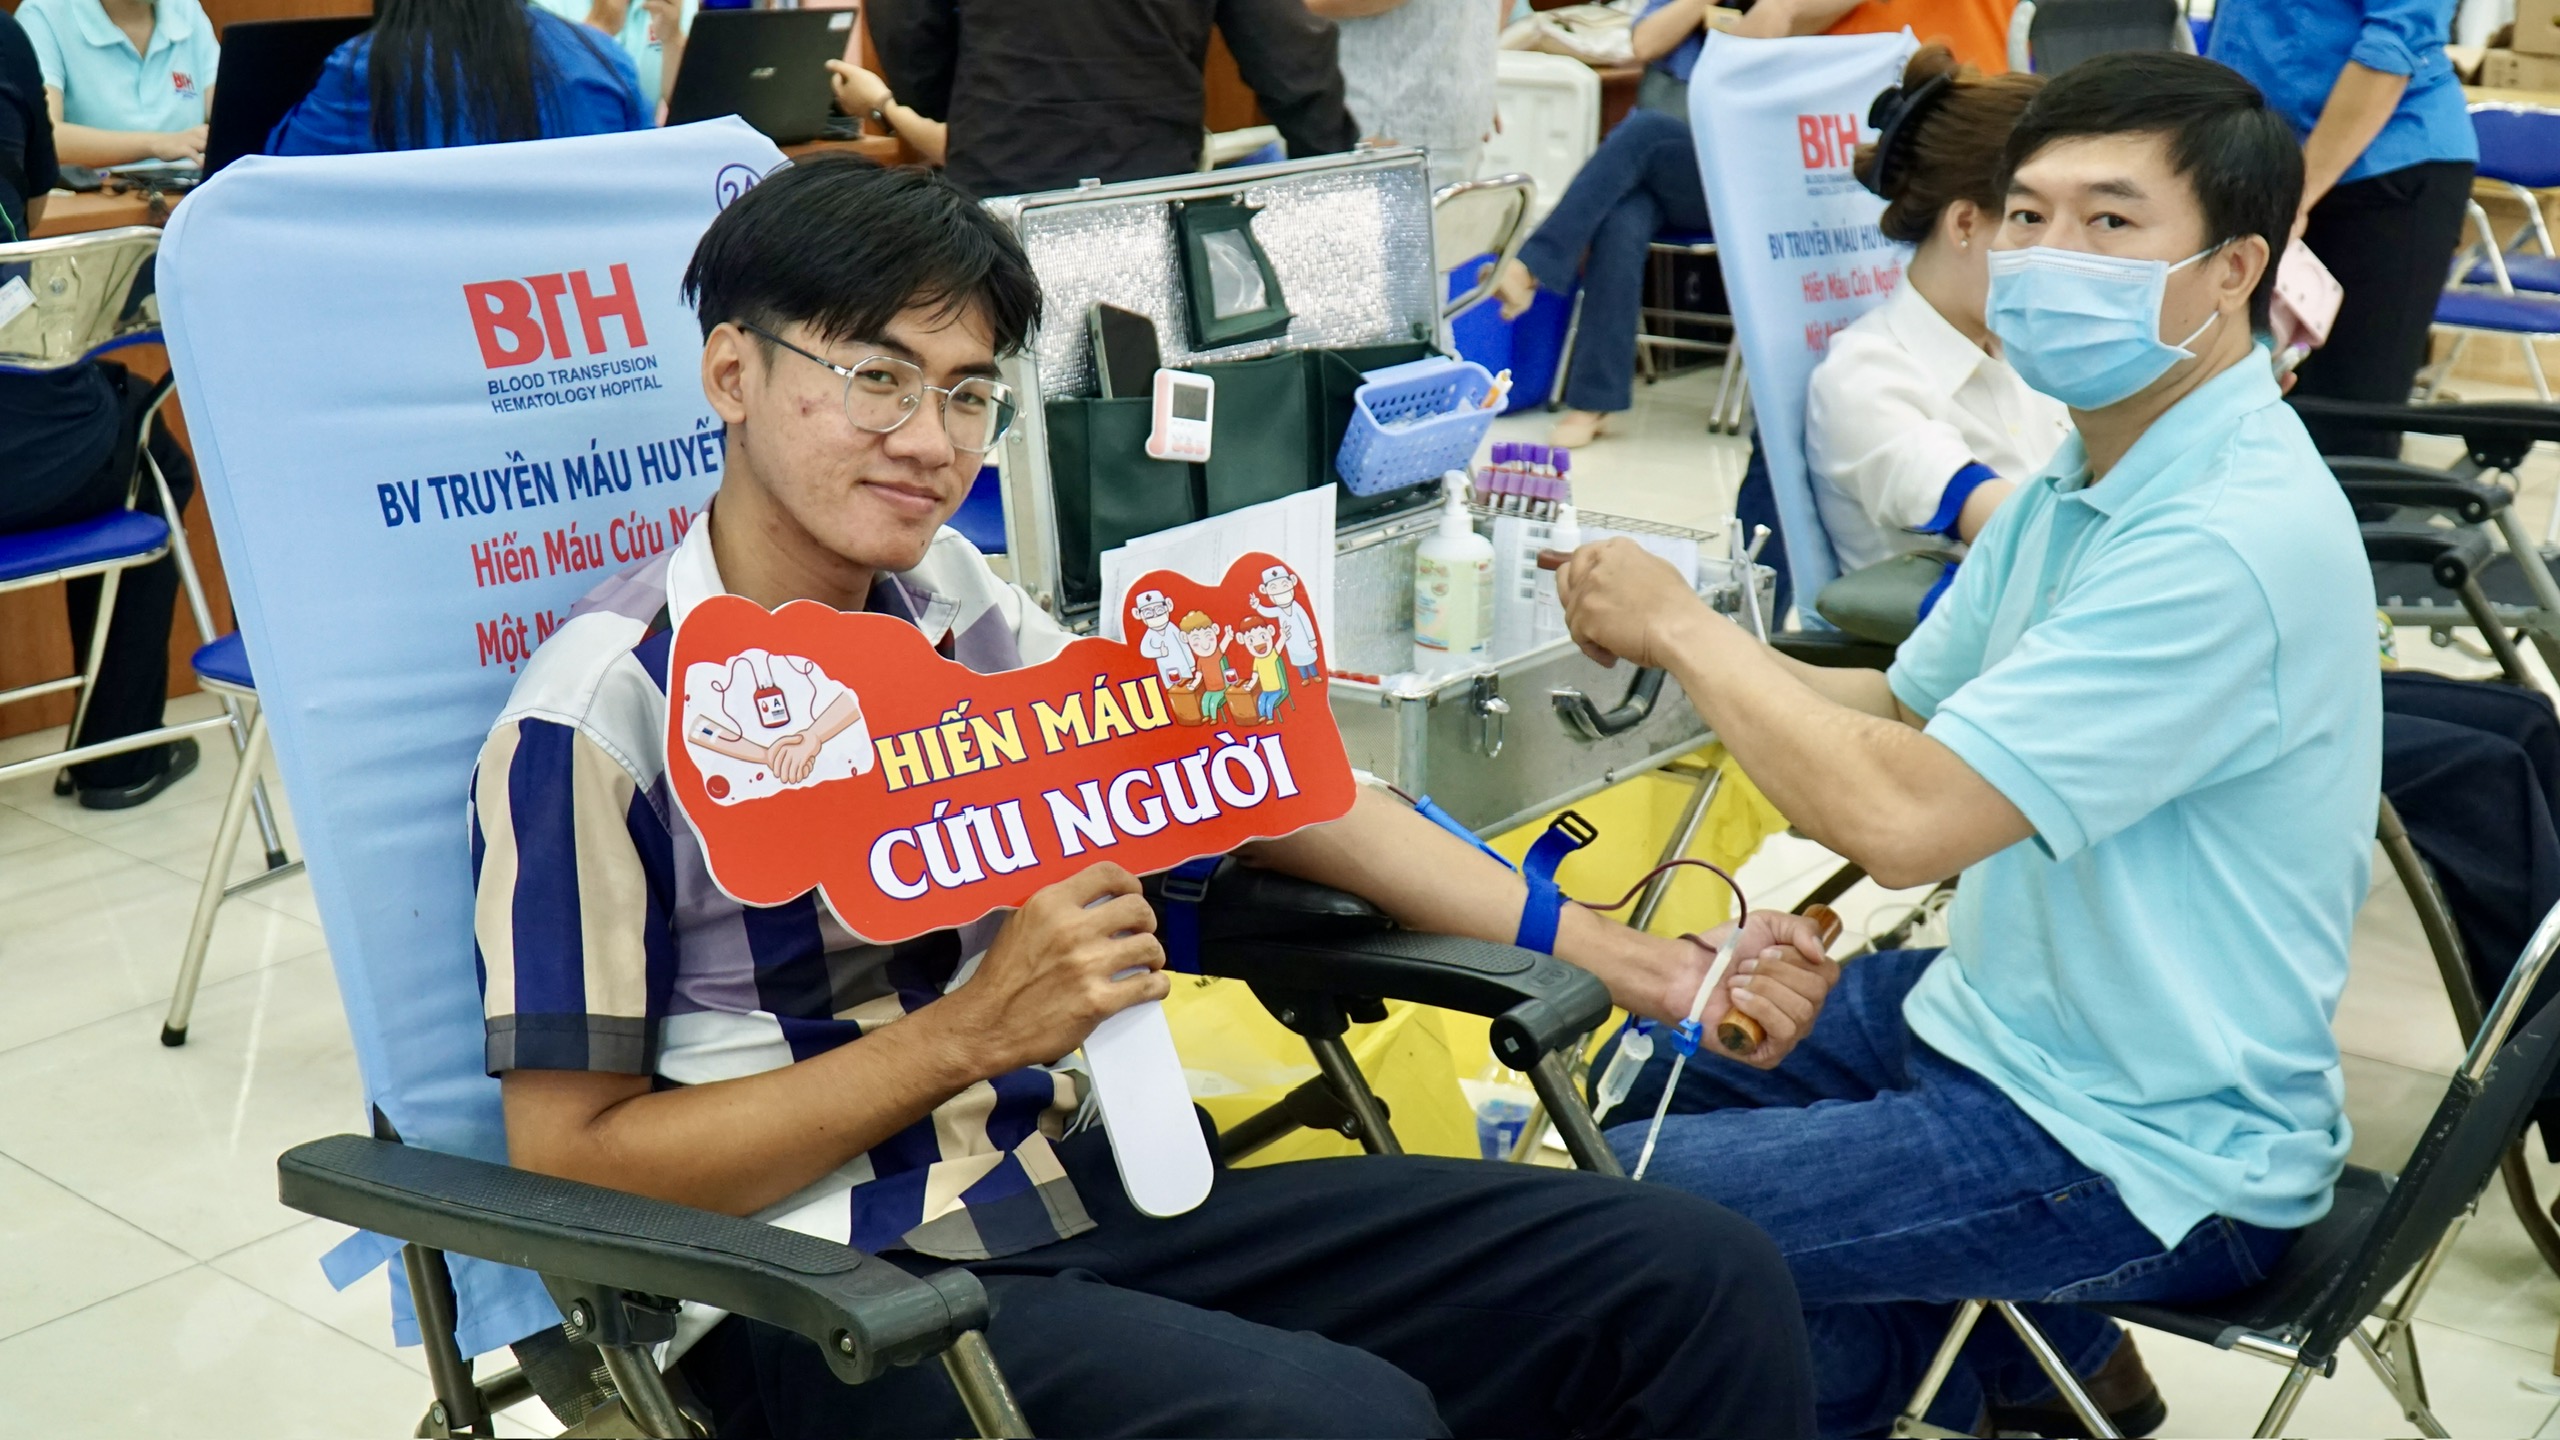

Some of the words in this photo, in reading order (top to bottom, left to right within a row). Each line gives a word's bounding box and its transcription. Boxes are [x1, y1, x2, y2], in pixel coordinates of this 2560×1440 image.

[1798, 113, 1858, 169] BTH
[1768, 233, 1785, 259] BV
[463, 263, 648, 369] BTH
[487, 373, 545, 395] BLOOD
[548, 355, 658, 386] TRANSFUSION
[491, 386, 597, 413] HEMATOLOGY
[601, 374, 663, 398] HOPITAL
[377, 479, 421, 527] BV
[428, 451, 559, 520] TRUYỀN
[562, 438, 631, 501] MÁU
[470, 532, 539, 588] Hiến
[543, 521, 605, 576] Máu
[610, 510, 664, 562] Cứu
[476, 612, 531, 673] Một
[873, 699, 1028, 794] HIẾN
[1031, 673, 1173, 755] MÁU
[868, 800, 1037, 900] CỨU
[1041, 731, 1300, 858] NGƯỜI
